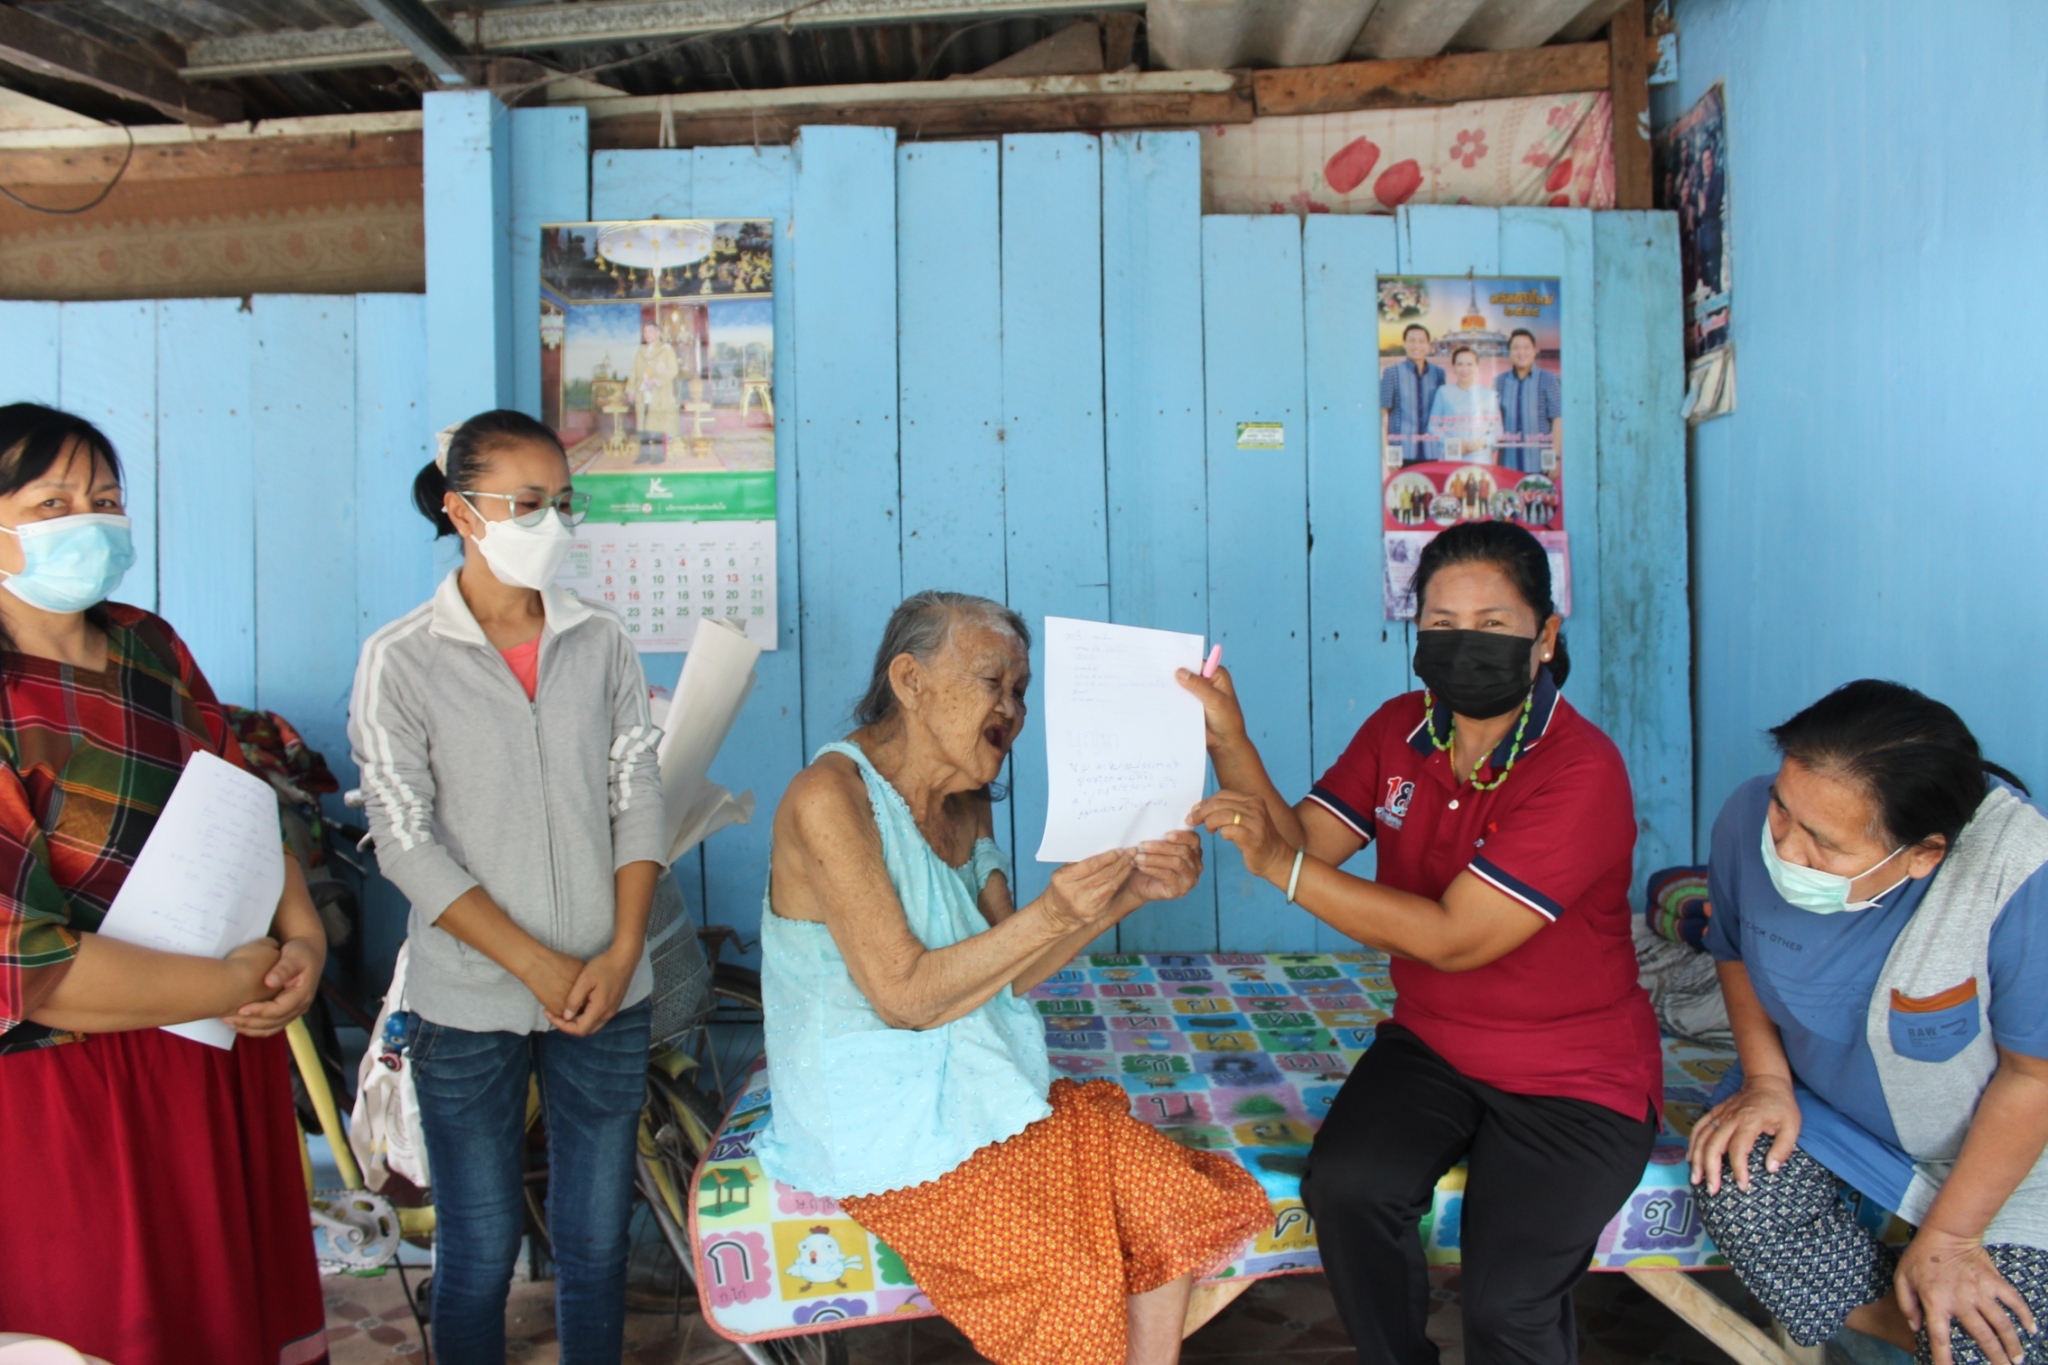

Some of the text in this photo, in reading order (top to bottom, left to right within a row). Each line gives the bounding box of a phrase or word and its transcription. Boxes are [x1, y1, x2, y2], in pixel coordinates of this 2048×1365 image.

[629, 558, 637, 569] 2
[654, 558, 662, 568] 3
[679, 558, 686, 567] 4
[703, 557, 711, 567] 5
[728, 557, 735, 567] 6
[753, 557, 760, 566] 7
[605, 573, 764, 585] 8 9 10 11 12 13 14
[603, 589, 763, 601] 15 16 17 18 19 20 21
[627, 605, 764, 617] 23 24 25 26 27 28
[627, 623, 664, 633] 30 31
[1769, 932, 1804, 953] OTHER
[1907, 1027, 1938, 1038] RAW
[706, 1240, 751, 1285] ก
